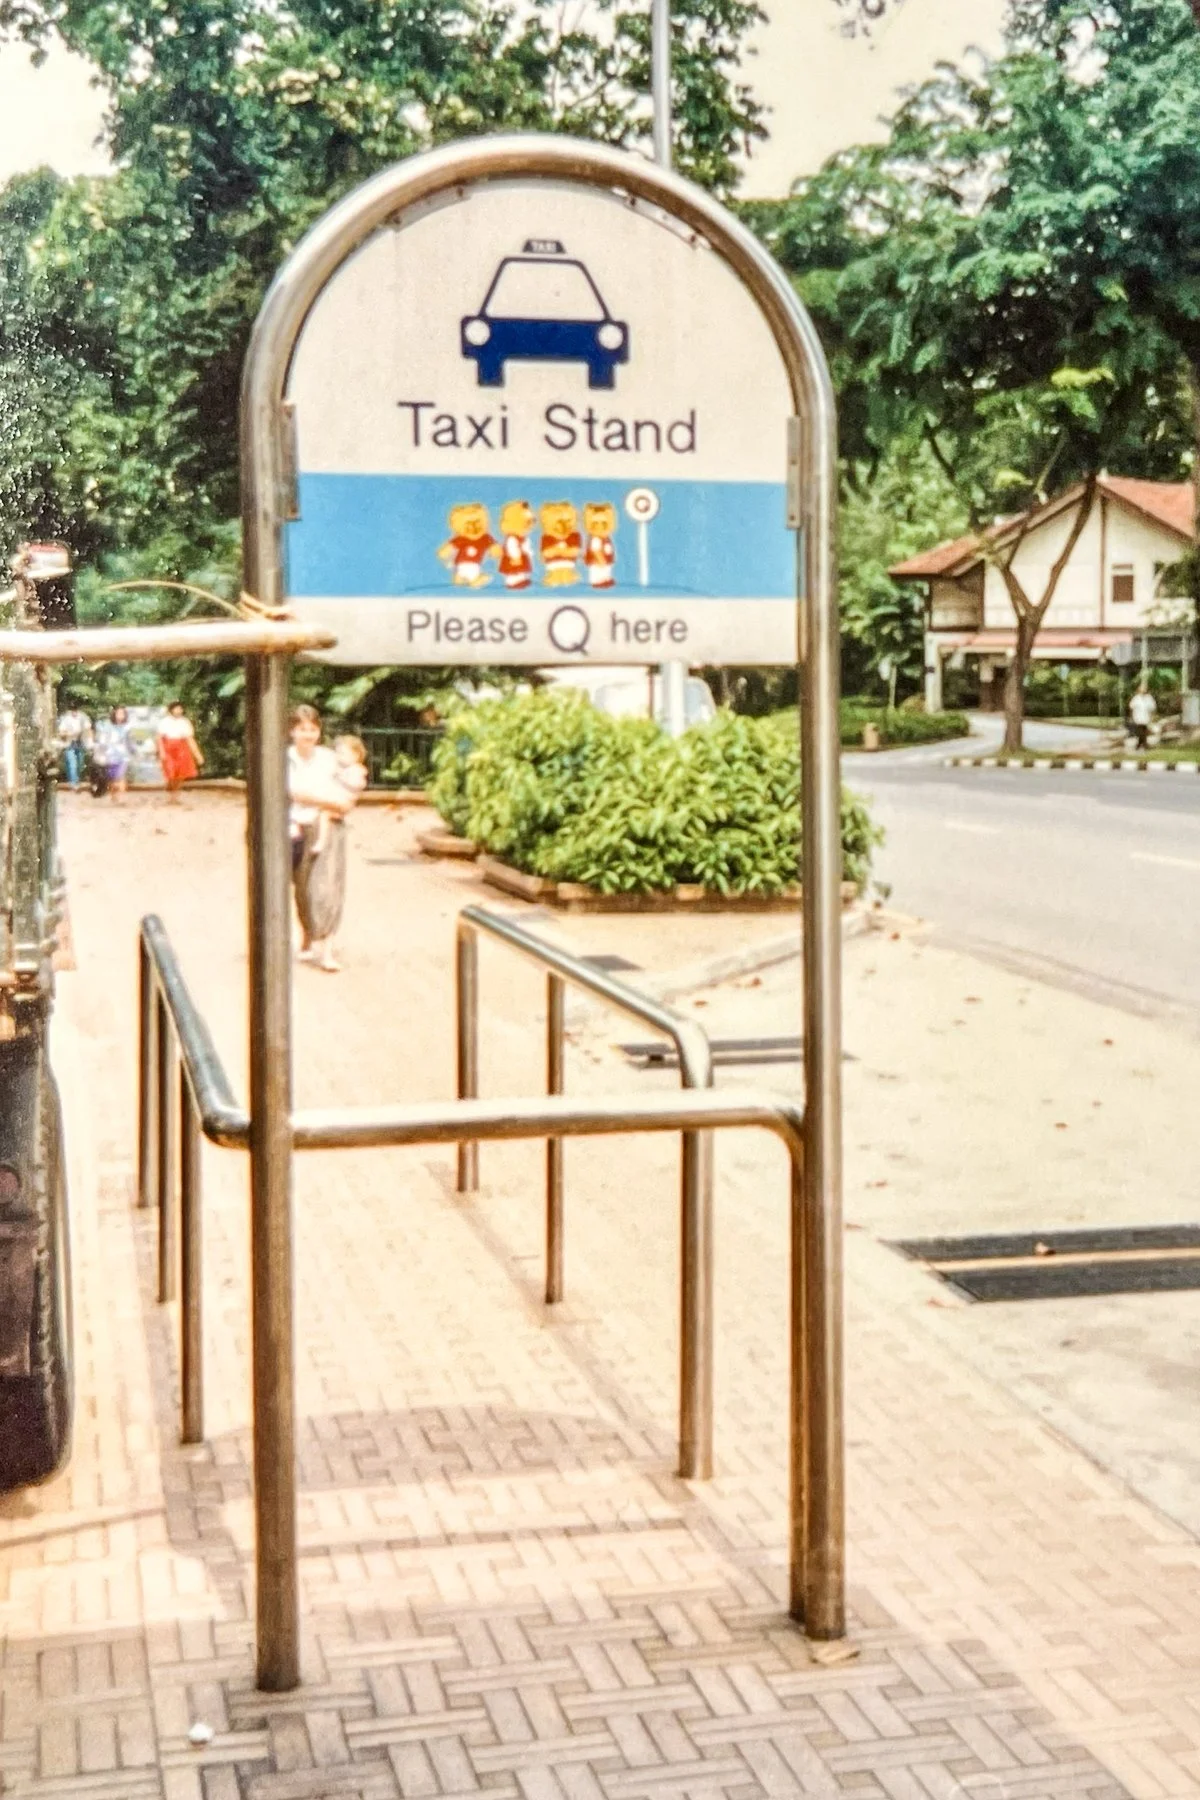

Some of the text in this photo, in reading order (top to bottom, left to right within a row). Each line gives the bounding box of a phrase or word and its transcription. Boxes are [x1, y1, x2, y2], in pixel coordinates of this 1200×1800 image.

[397, 401, 696, 453] Taxi Stand
[407, 606, 688, 655] Please Q here
